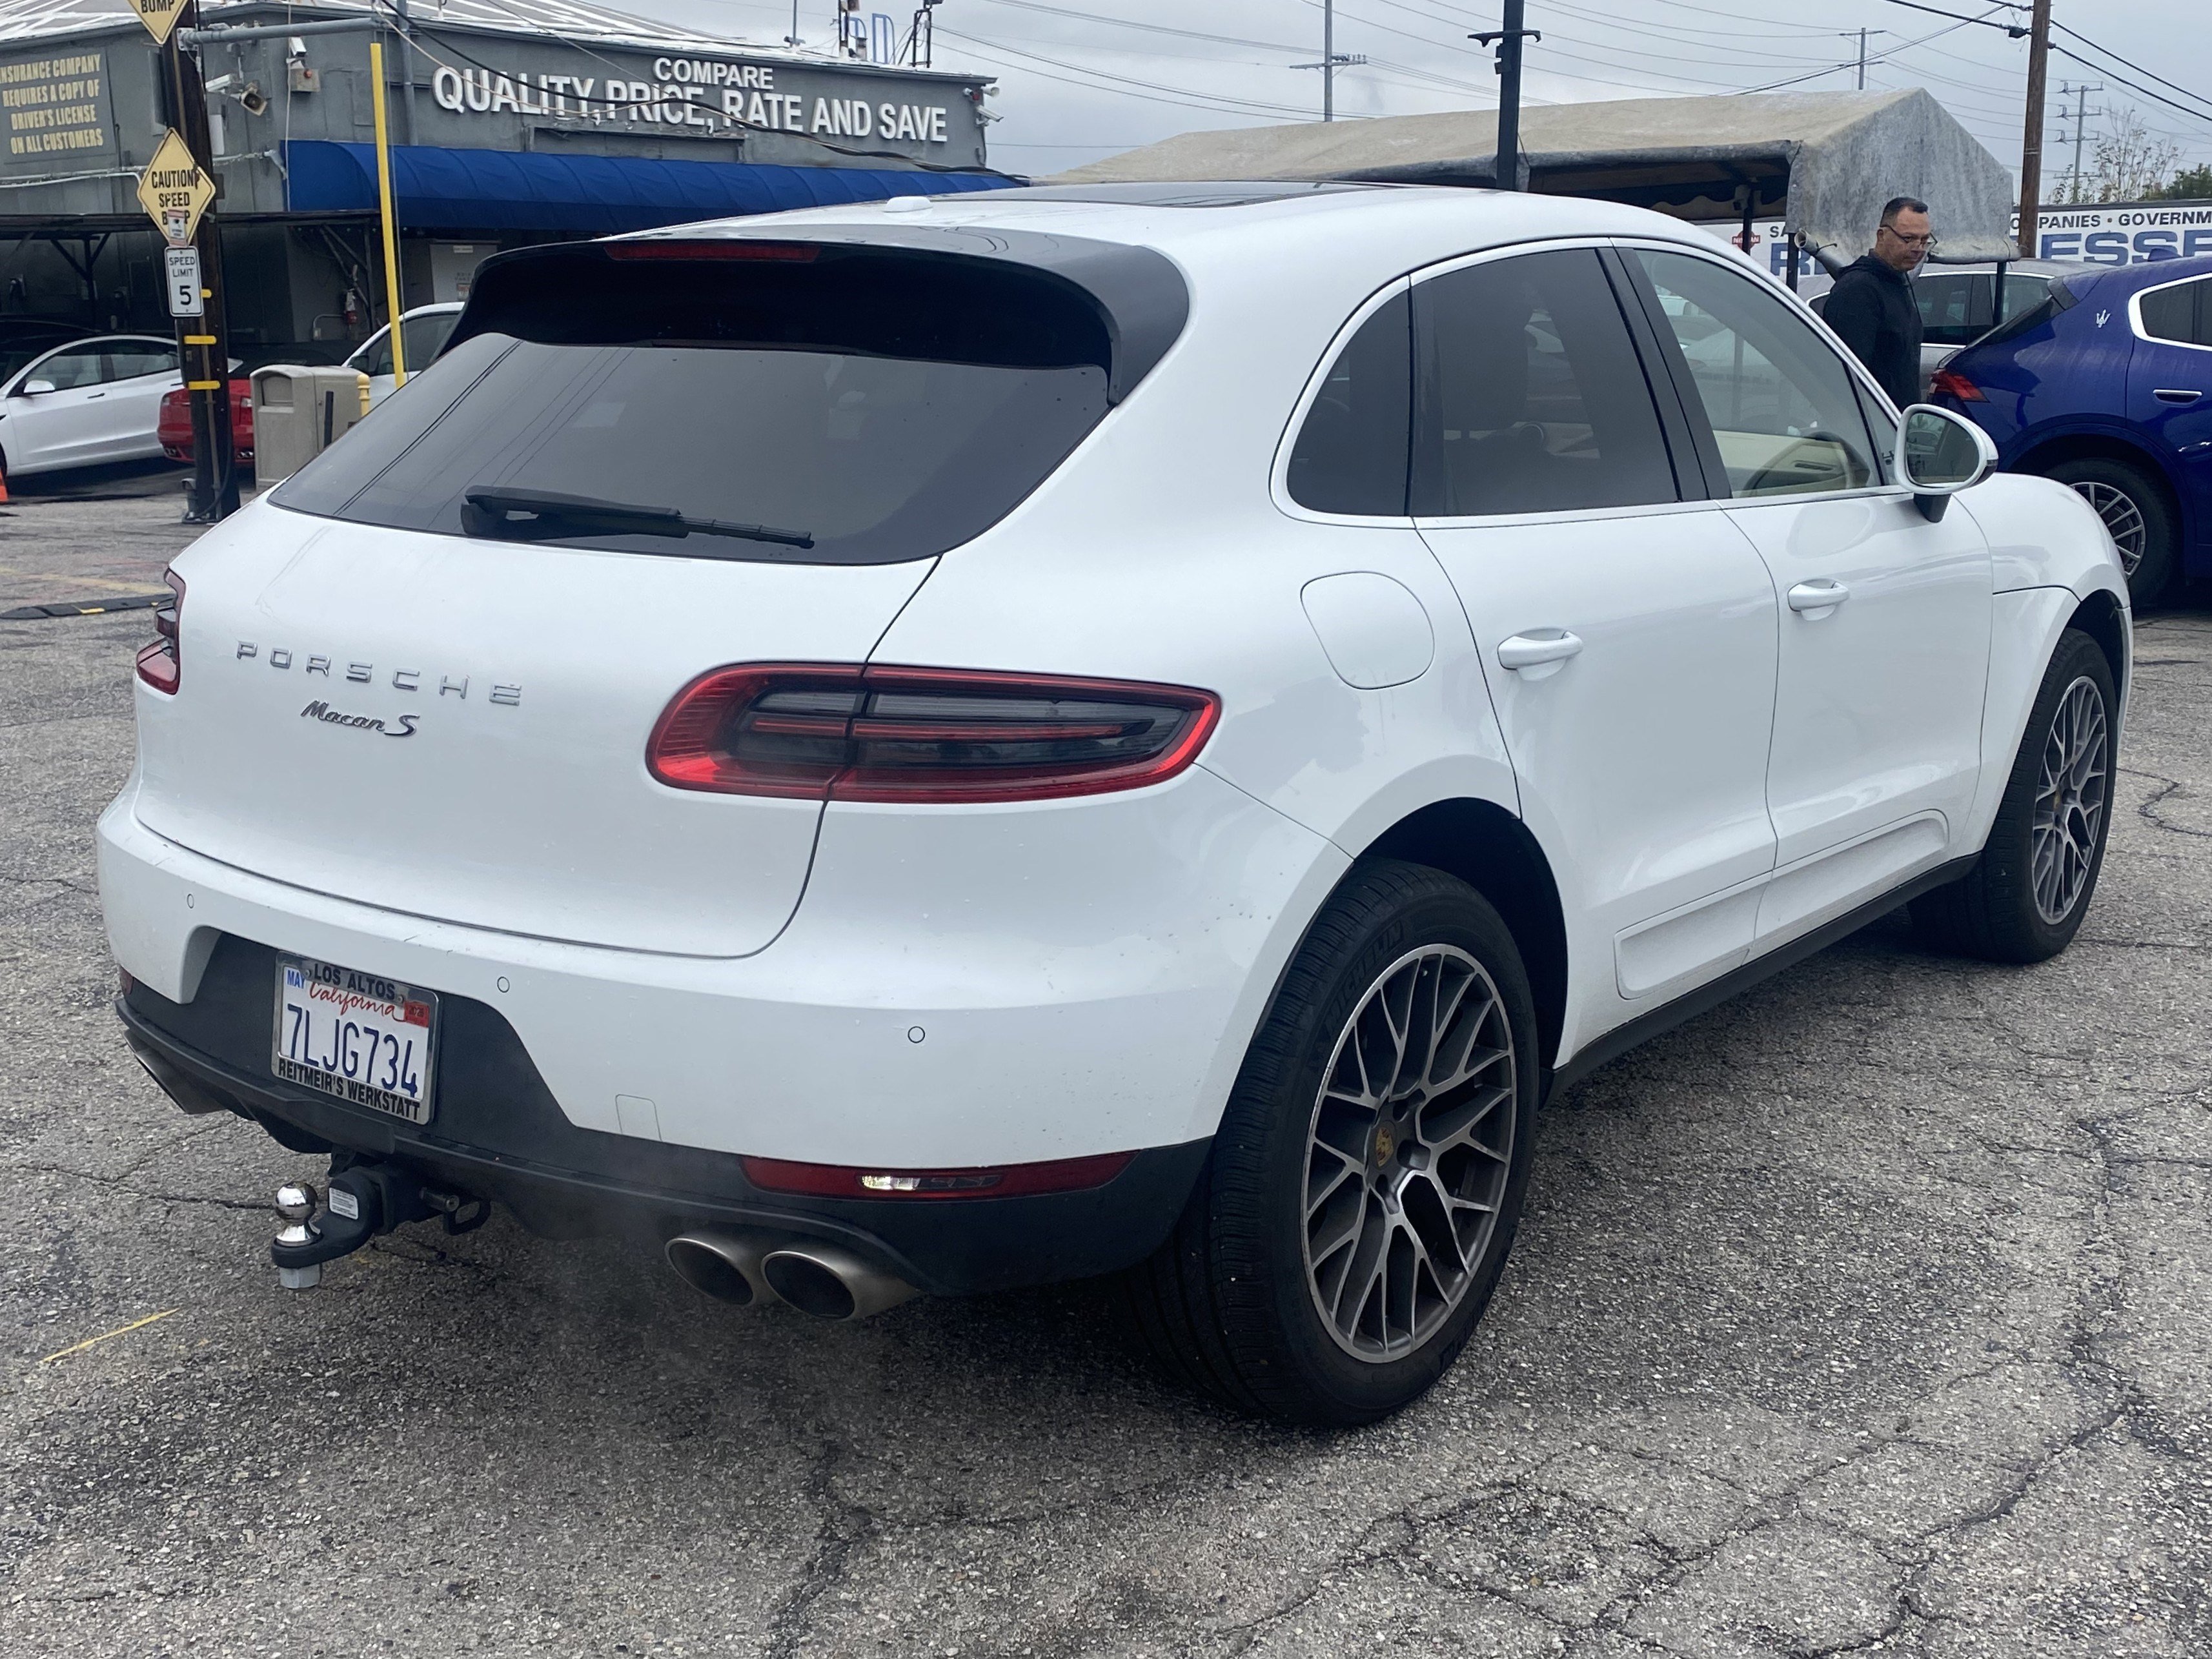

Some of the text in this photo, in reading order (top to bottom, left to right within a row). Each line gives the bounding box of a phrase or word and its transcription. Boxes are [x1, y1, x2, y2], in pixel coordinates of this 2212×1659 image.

[141, 0, 174, 13] BUMP
[52, 54, 101, 77] COMPANY
[653, 57, 774, 90] COMPARE
[3, 79, 100, 108] REQUIRES A COPY OF
[432, 65, 948, 143] QUALITY, PRICE, RATE AND SAVE
[11, 104, 97, 131] DRIVER'S LICENSE
[10, 128, 104, 154] ON ALL CUSTOMERS
[152, 169, 195, 188] CAUTION
[159, 192, 190, 207] SPEED
[161, 210, 190, 225] BP
[2010, 214, 2100, 230] OPANIES
[168, 256, 196, 266] SPEED
[172, 269, 194, 278] LIMIT
[179, 285, 192, 305] 5
[236, 640, 522, 706] PORSCHE
[301, 699, 420, 737] Macan S
[287, 970, 305, 990] MAY
[314, 963, 396, 1001] LOS ALTOS
[309, 982, 406, 1023] California
[287, 1003, 418, 1098] 7LJG734
[278, 1059, 420, 1121] REITMEIR'S WERKSTATT
